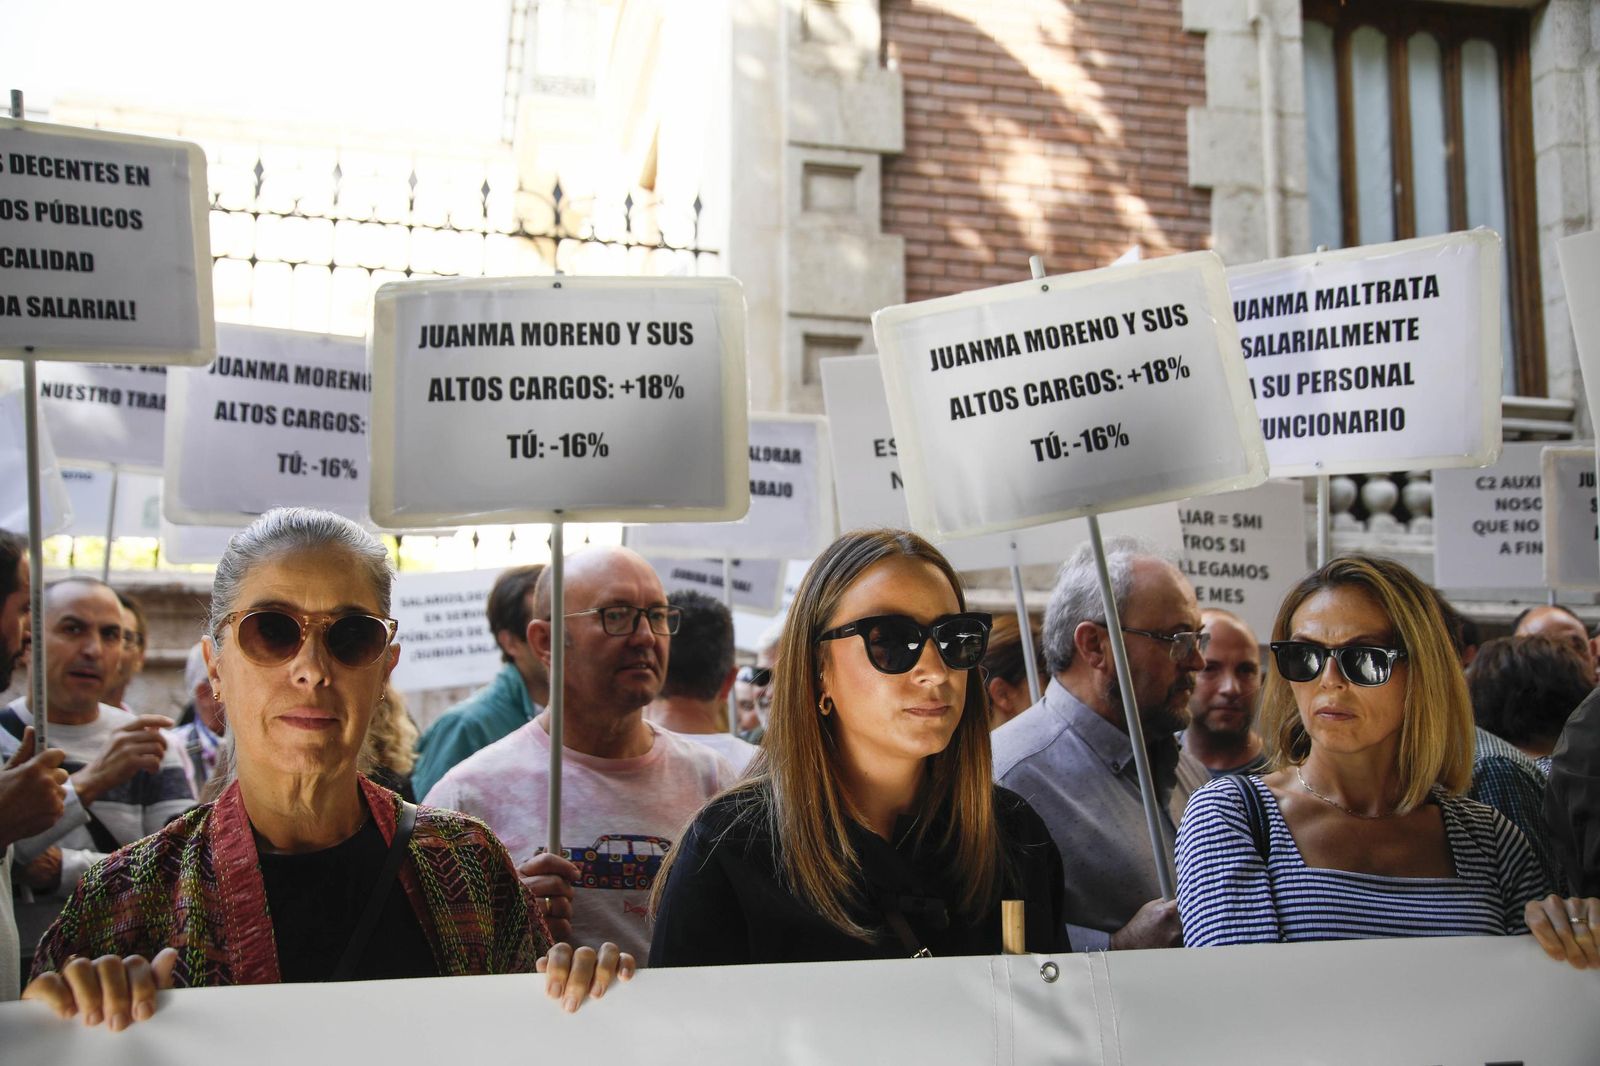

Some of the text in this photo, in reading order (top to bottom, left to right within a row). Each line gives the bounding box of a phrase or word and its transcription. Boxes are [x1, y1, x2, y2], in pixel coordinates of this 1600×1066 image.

[9, 153, 119, 184] DECENTES
[125, 165, 150, 186] EN
[35, 199, 143, 230] PÚBLICOS
[0, 247, 94, 272] CALIDAD
[1315, 274, 1440, 311] MALTRATA
[27, 296, 136, 321] SALARIAL!
[418, 321, 694, 349] JUANMA MORENO Y SUS
[930, 303, 1189, 372] JUANMA MORENO Y SUS
[1240, 317, 1420, 360] SALARIALMENTE
[40, 381, 122, 406] NUESTRO
[428, 374, 685, 402] ALTOS CARGOS: +18%
[949, 354, 1191, 421] ALTOS CARGOS: +18%
[1262, 374, 1290, 399] SU
[1296, 362, 1415, 396] PERSONAL
[214, 400, 366, 434] ALTOS CARGOS:
[1260, 407, 1406, 441] UNCIONARIO
[507, 429, 609, 459] TÚ: -16%
[1030, 422, 1130, 463] TÚ: -16%
[277, 451, 358, 479] TÚ: -16%
[1475, 476, 1496, 490] C2
[1579, 472, 1597, 488] JU
[1232, 513, 1263, 529] SMI
[1472, 519, 1540, 537] QUE NO
[1230, 538, 1245, 553] SI
[1499, 541, 1543, 554] A FIN
[1209, 587, 1245, 604] MES
